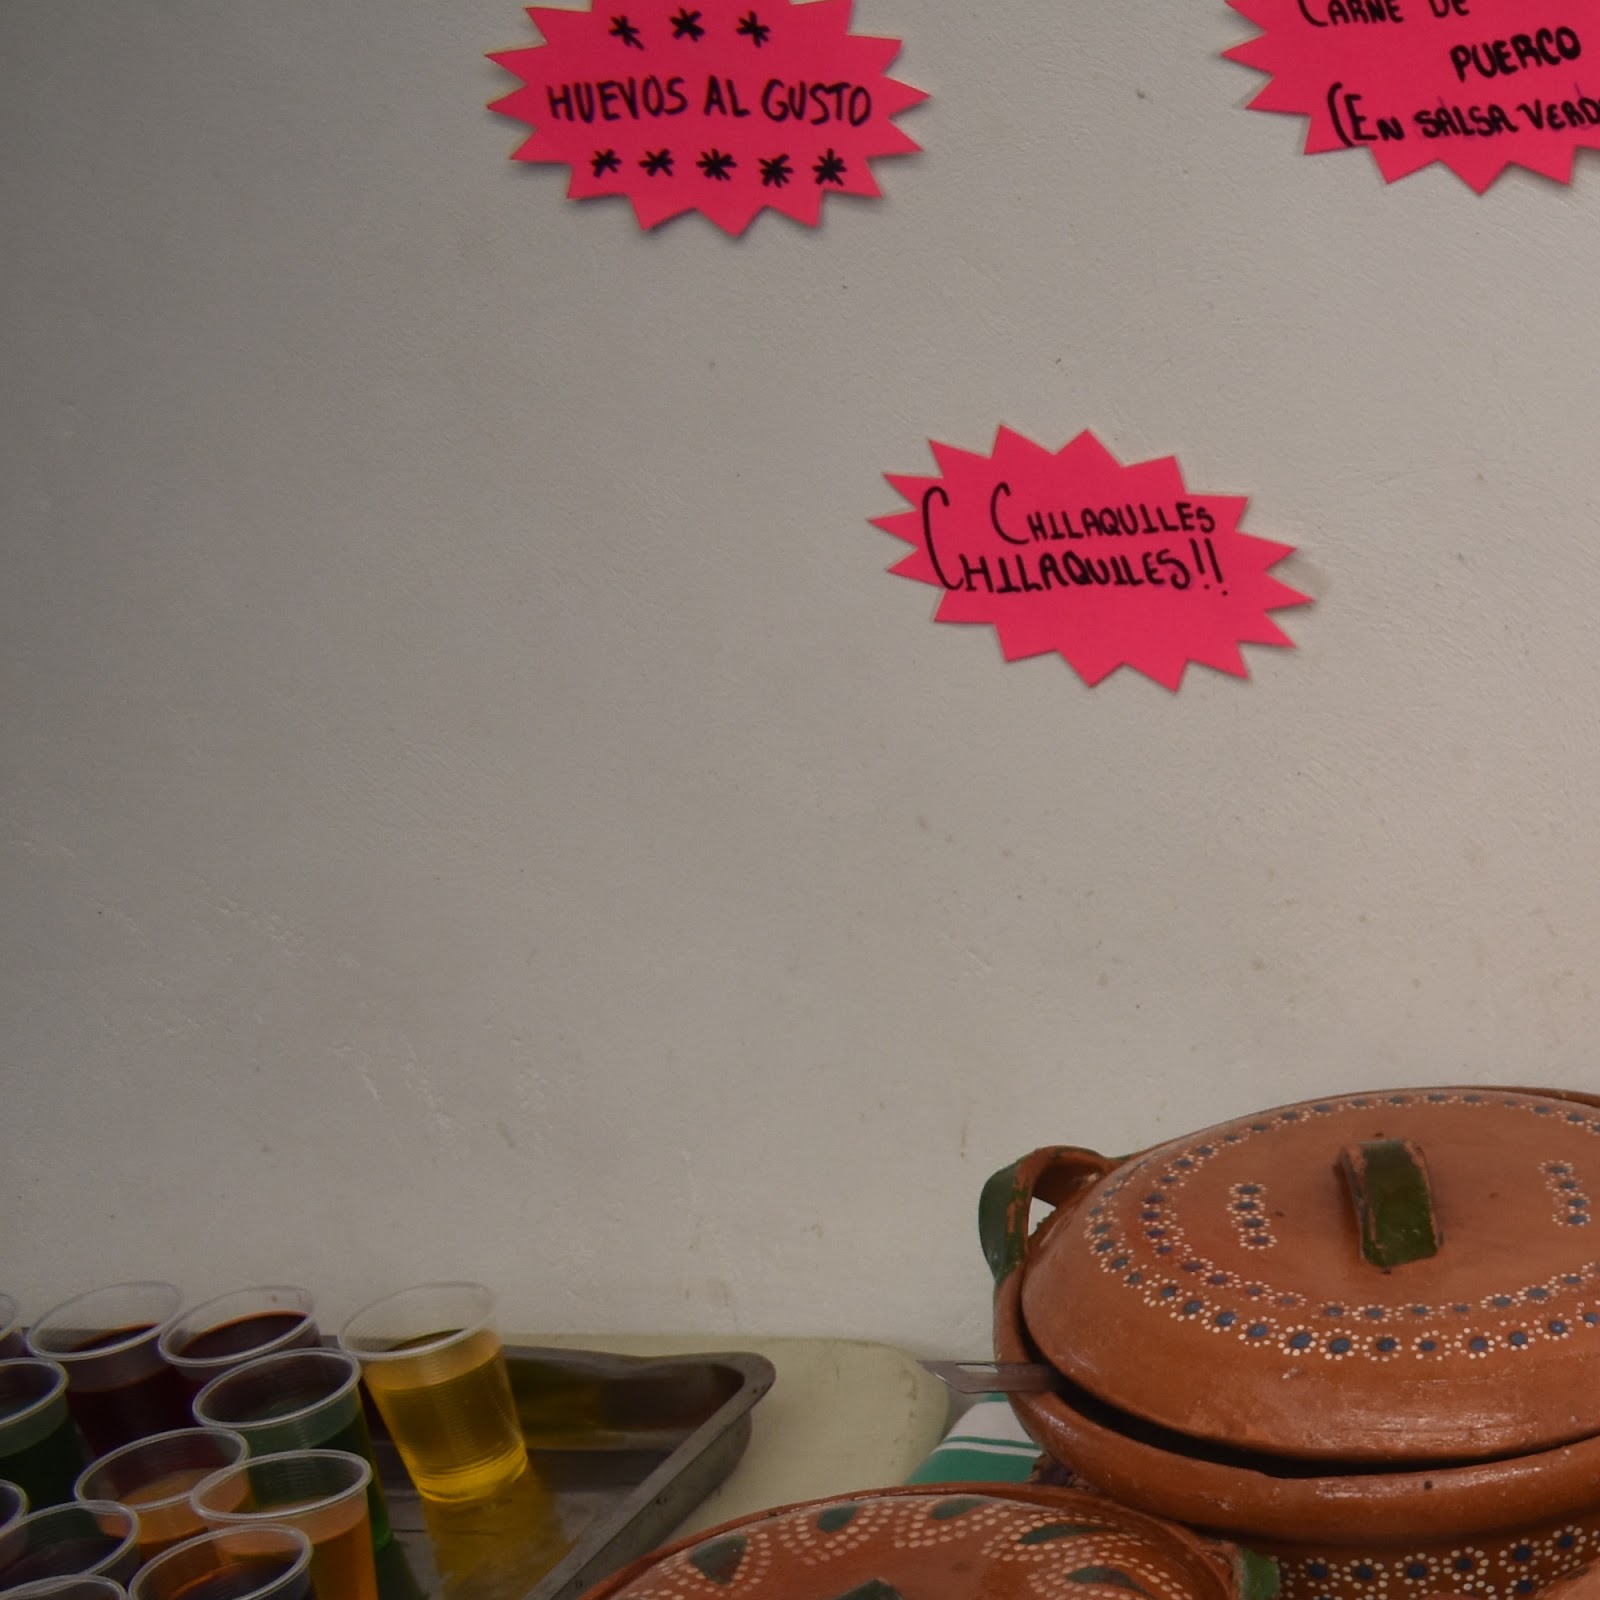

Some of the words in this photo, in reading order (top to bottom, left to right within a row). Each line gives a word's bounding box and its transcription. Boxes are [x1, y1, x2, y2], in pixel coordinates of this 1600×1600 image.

[1449, 26, 1582, 83] PUERCO
[546, 74, 688, 124] HUEVOS
[703, 74, 750, 118] AL
[761, 79, 872, 127] GUSTO
[1327, 74, 1405, 148] (EN
[1413, 100, 1518, 139] SALSA
[922, 485, 1229, 597] CHILAQUILES!!
[990, 482, 1217, 546] CHILAQUILES
